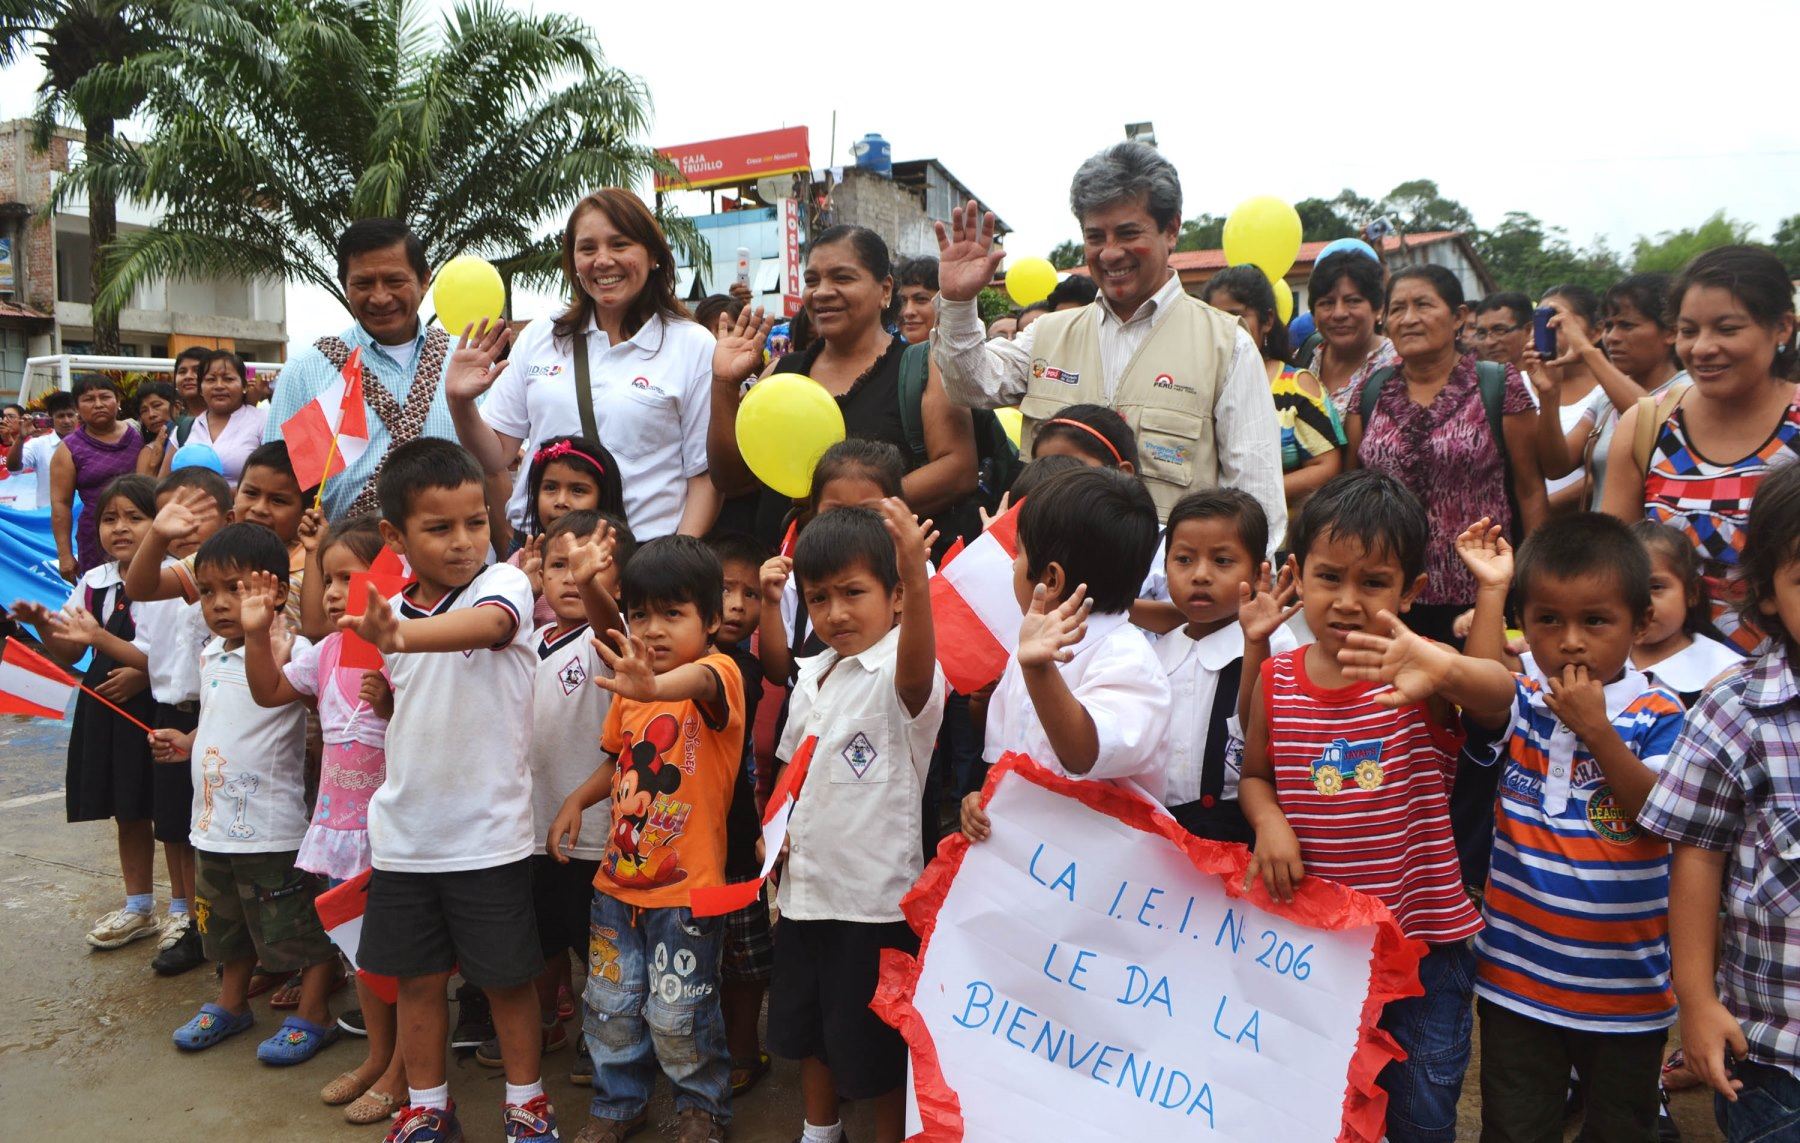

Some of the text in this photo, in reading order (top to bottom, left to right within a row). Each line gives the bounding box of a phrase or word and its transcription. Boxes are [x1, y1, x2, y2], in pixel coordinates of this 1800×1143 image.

[682, 153, 705, 165] CAJA
[683, 160, 723, 173] TRUJILLO
[787, 201, 798, 293] HOSTAL
[1572, 760, 1604, 789] CHA
[1029, 843, 1076, 902] LA
[1254, 930, 1314, 981] 206
[682, 983, 713, 999] Kids
[1043, 943, 1260, 1053] LE DA LA
[952, 981, 1215, 1129] BIENVENIDA
